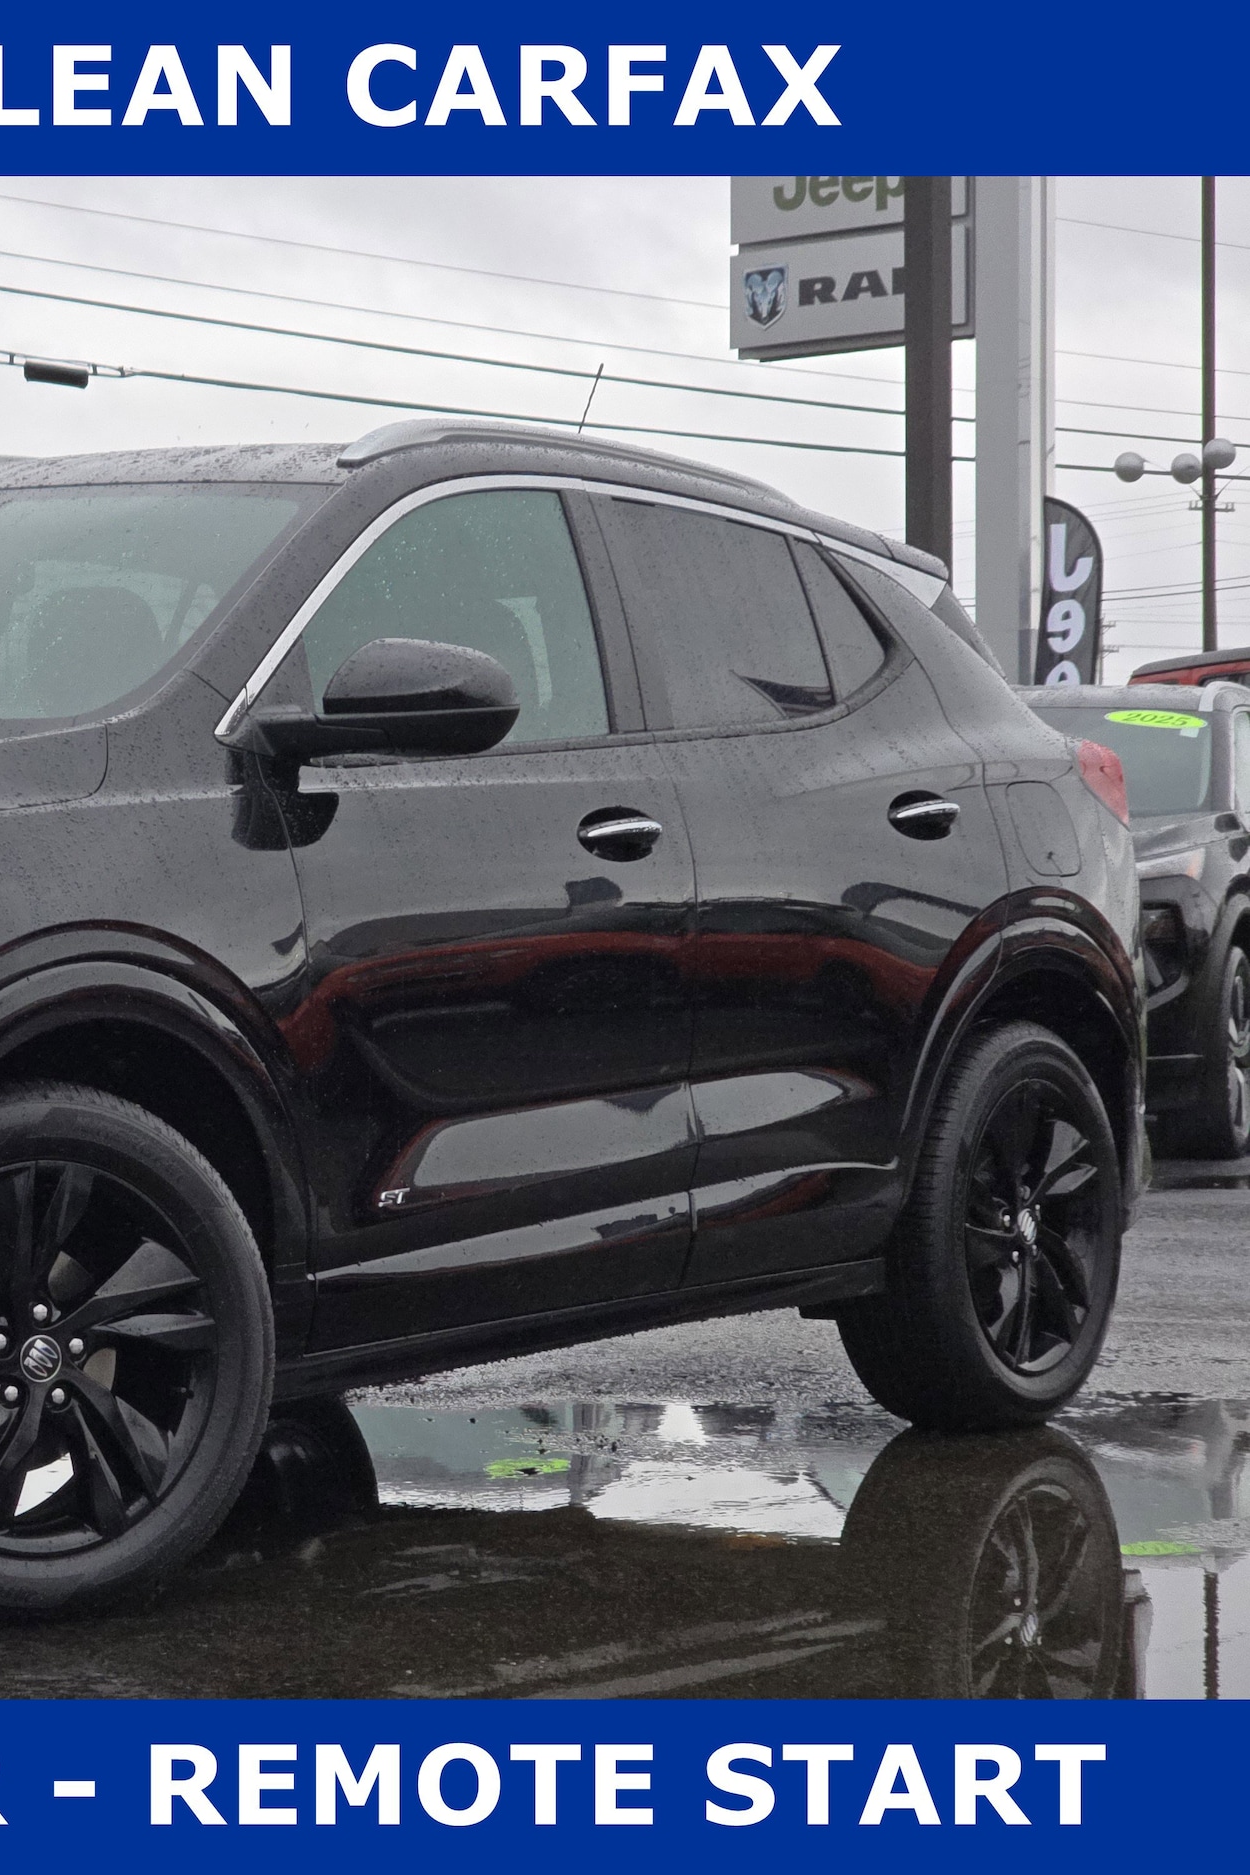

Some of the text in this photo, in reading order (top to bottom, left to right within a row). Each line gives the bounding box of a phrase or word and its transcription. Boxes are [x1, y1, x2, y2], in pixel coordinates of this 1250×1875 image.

[798, 267, 905, 307] RA
[1122, 712, 1191, 727] 2025
[378, 1187, 411, 1208] ST
